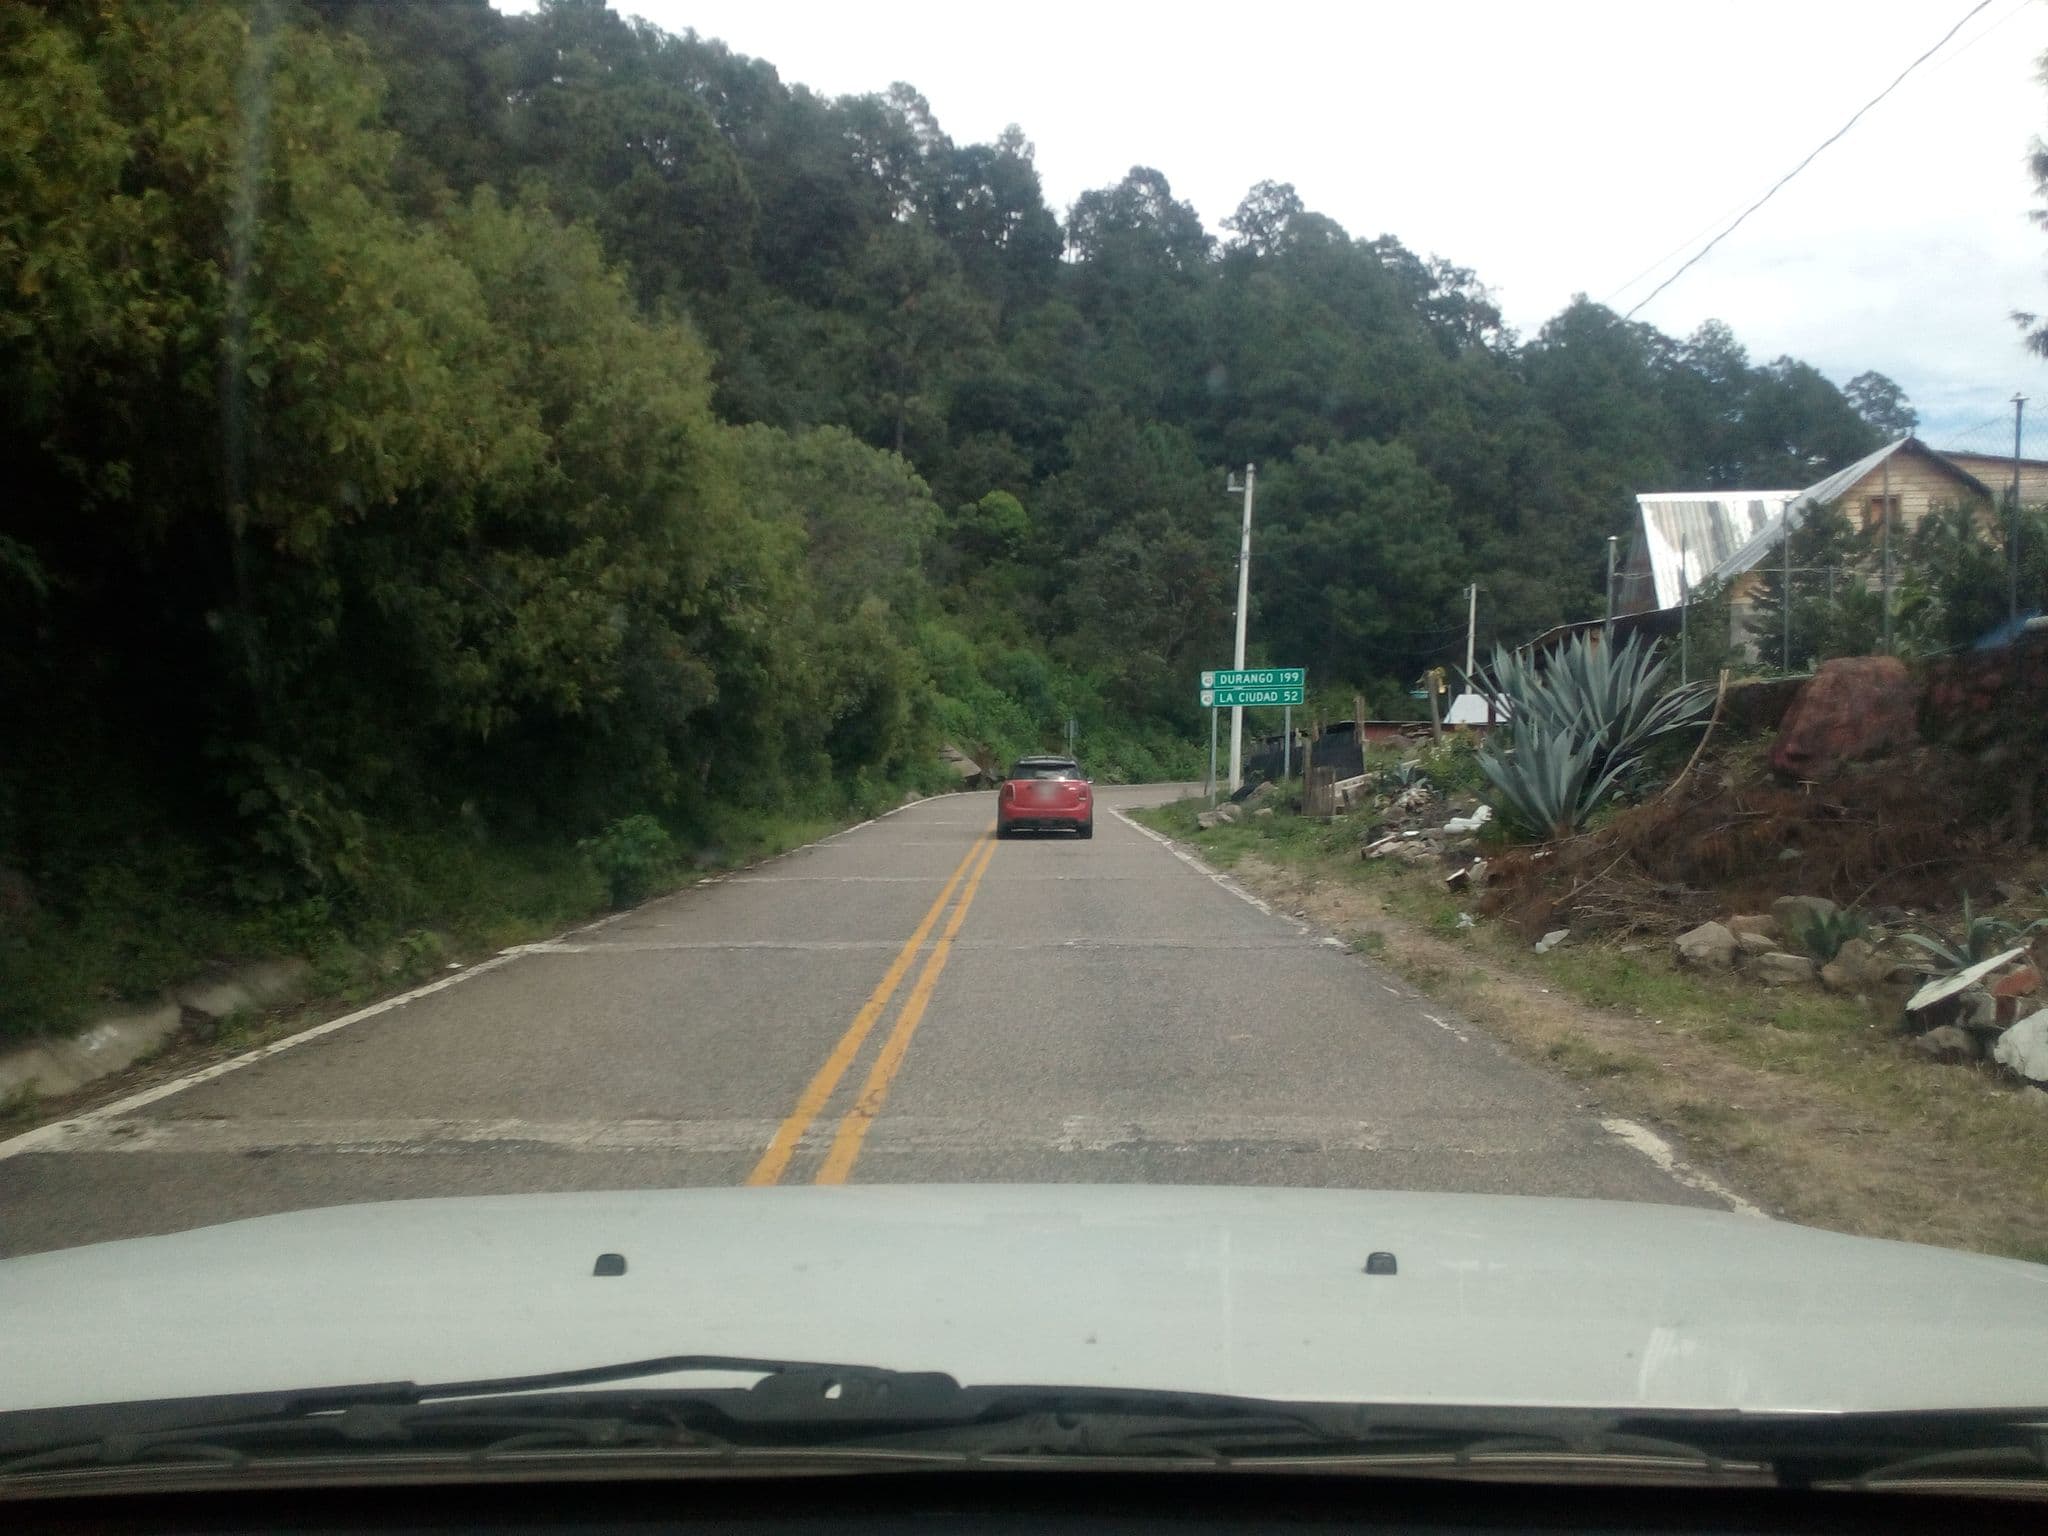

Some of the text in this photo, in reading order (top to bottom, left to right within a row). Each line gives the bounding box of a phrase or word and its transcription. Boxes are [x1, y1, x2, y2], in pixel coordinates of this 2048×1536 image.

[1220, 673, 1273, 685] DURANGO
[1280, 672, 1299, 682] 199
[1219, 693, 1233, 703] LA
[1238, 691, 1278, 702] CIUDAD
[1284, 691, 1298, 701] 52
